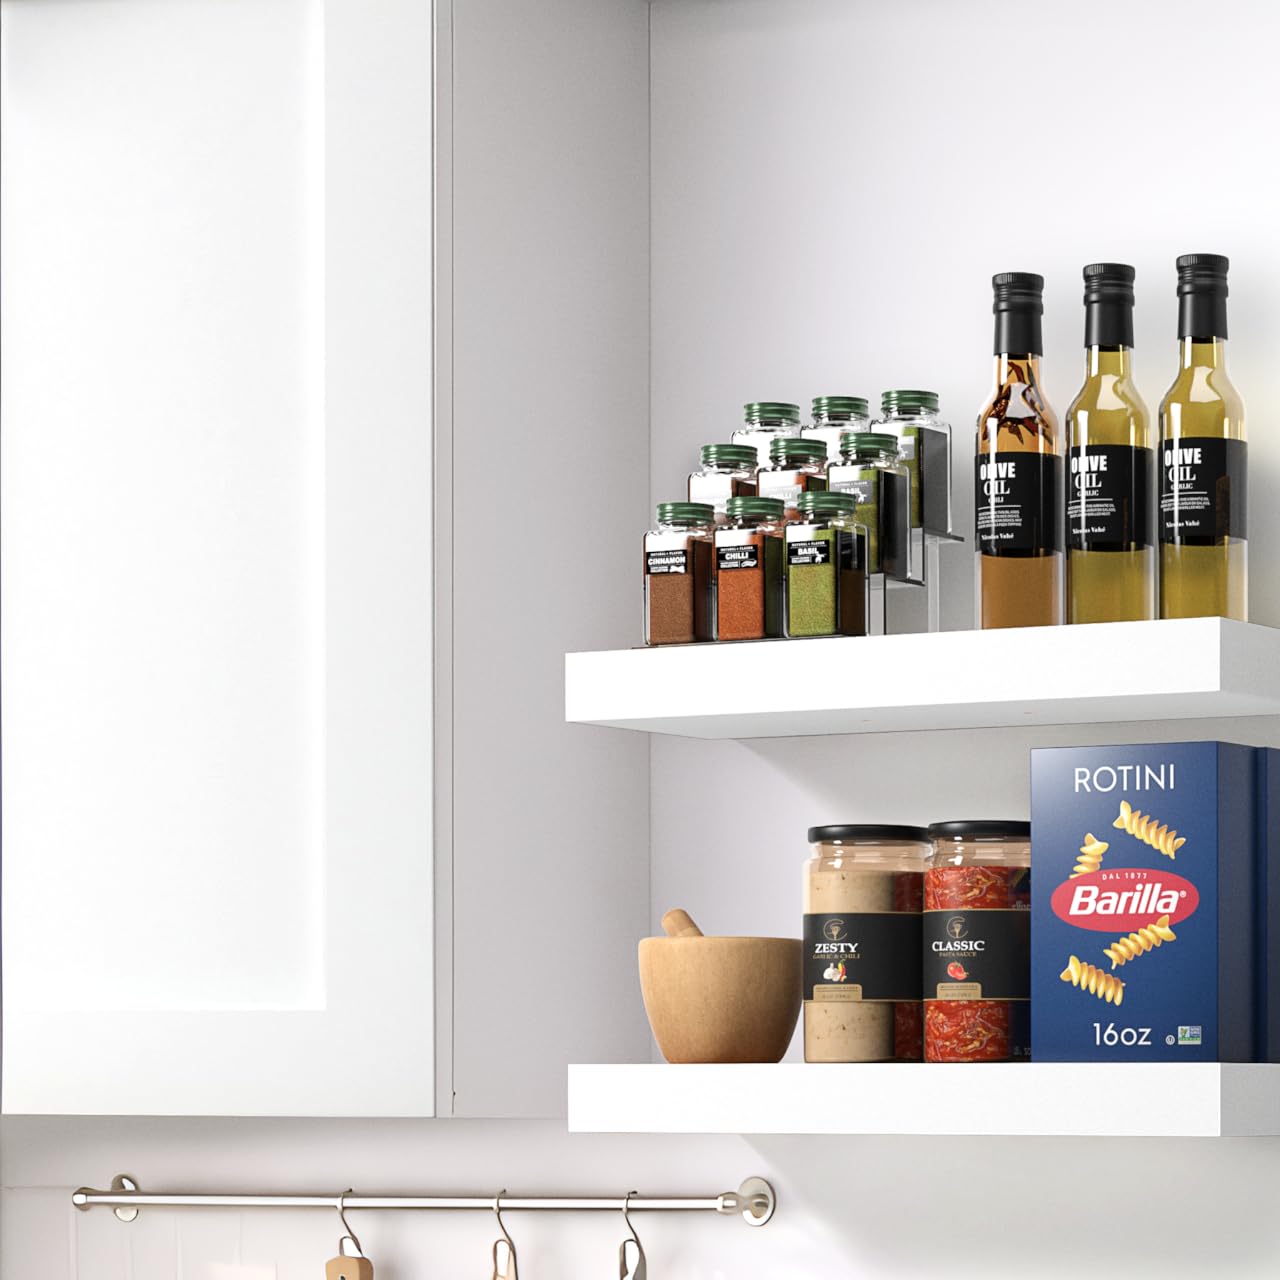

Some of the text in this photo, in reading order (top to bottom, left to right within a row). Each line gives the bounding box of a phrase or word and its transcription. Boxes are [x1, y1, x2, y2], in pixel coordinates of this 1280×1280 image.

[1168, 466, 1196, 482] OIL
[1075, 473, 1102, 489] OIL
[984, 480, 1010, 495] OIL
[1170, 483, 1193, 491] GRLIC
[1077, 489, 1100, 497] GRLIC
[725, 552, 749, 560] CHILLI
[798, 547, 819, 555] BASIL
[647, 556, 686, 566] CINNAMON
[1074, 764, 1175, 793] ROTINI
[1125, 872, 1148, 880] 1877
[1069, 883, 1179, 915] Barilla
[815, 943, 859, 953] ZESTY
[932, 940, 985, 951] CLASSIC
[1093, 1022, 1152, 1046] 16oz
